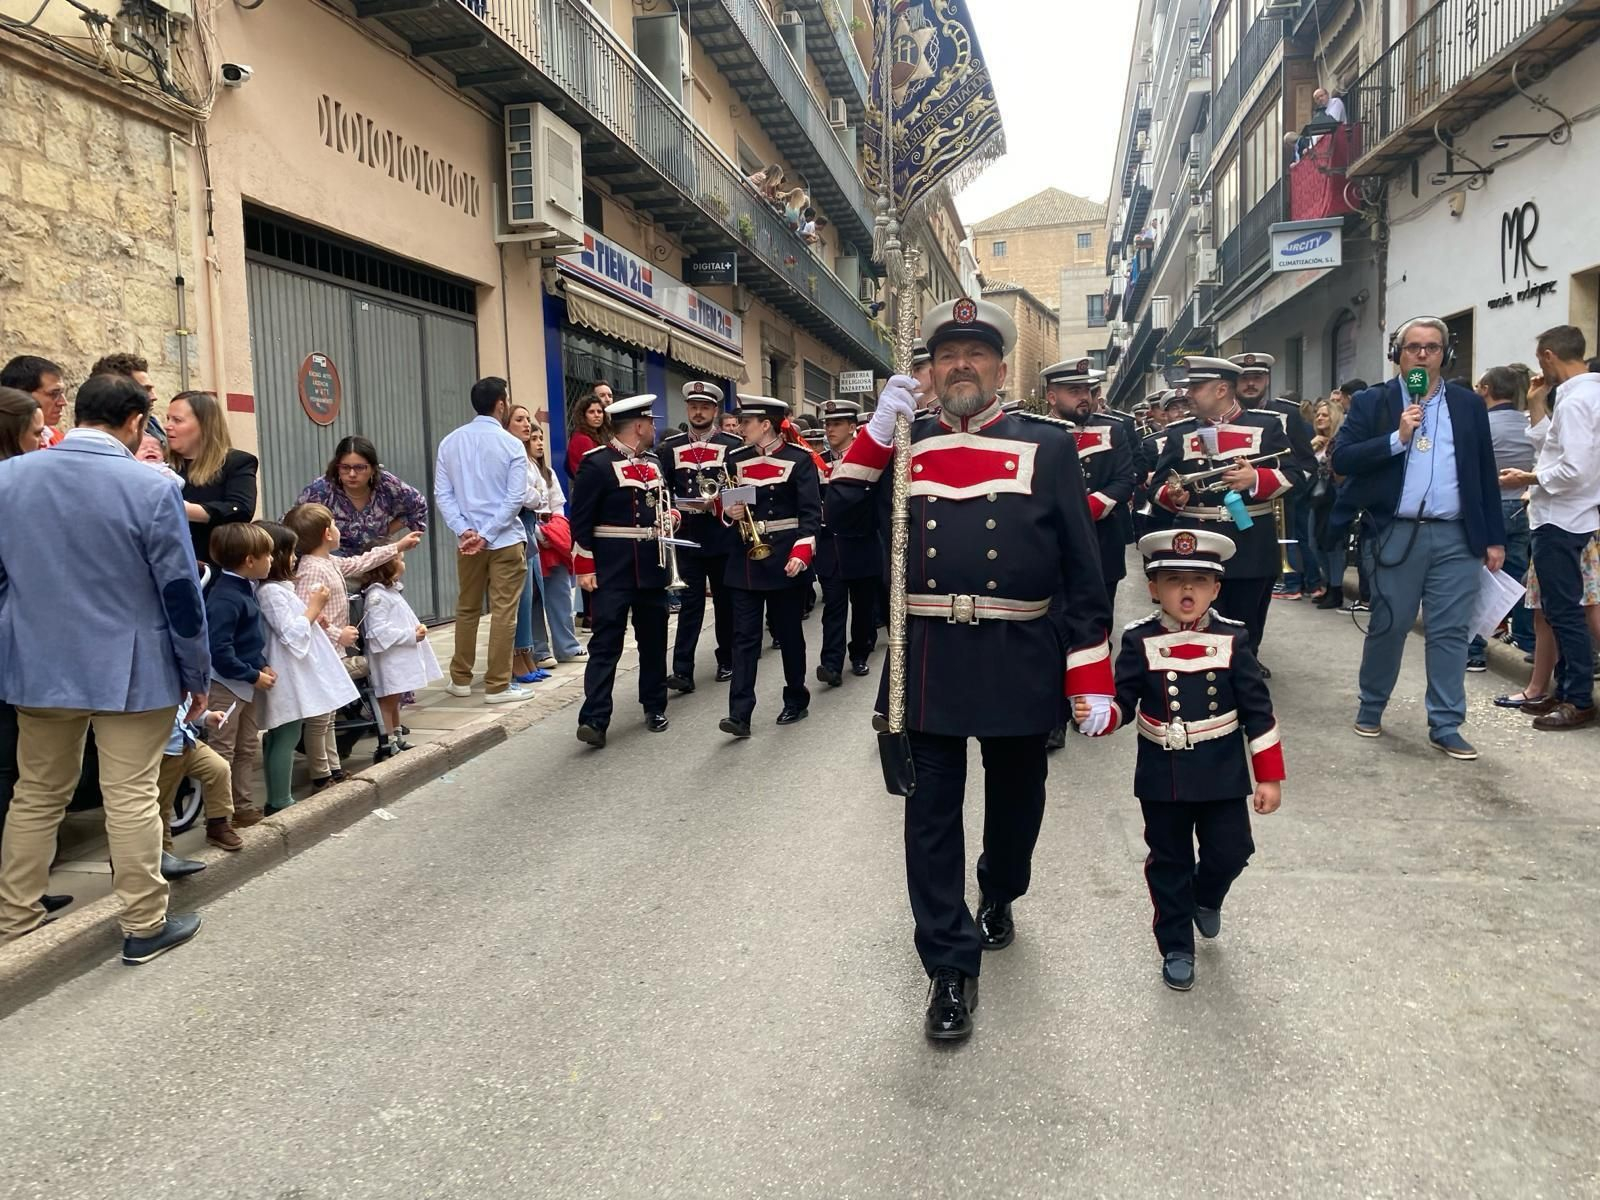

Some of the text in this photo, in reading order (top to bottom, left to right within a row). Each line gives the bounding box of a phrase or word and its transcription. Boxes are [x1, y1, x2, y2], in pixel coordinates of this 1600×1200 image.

[910, 129, 922, 145] SU
[1501, 201, 1548, 284] MR
[595, 239, 641, 293] TIEN 21
[692, 262, 732, 270] DIGITAL+
[697, 298, 717, 332] TIEN
